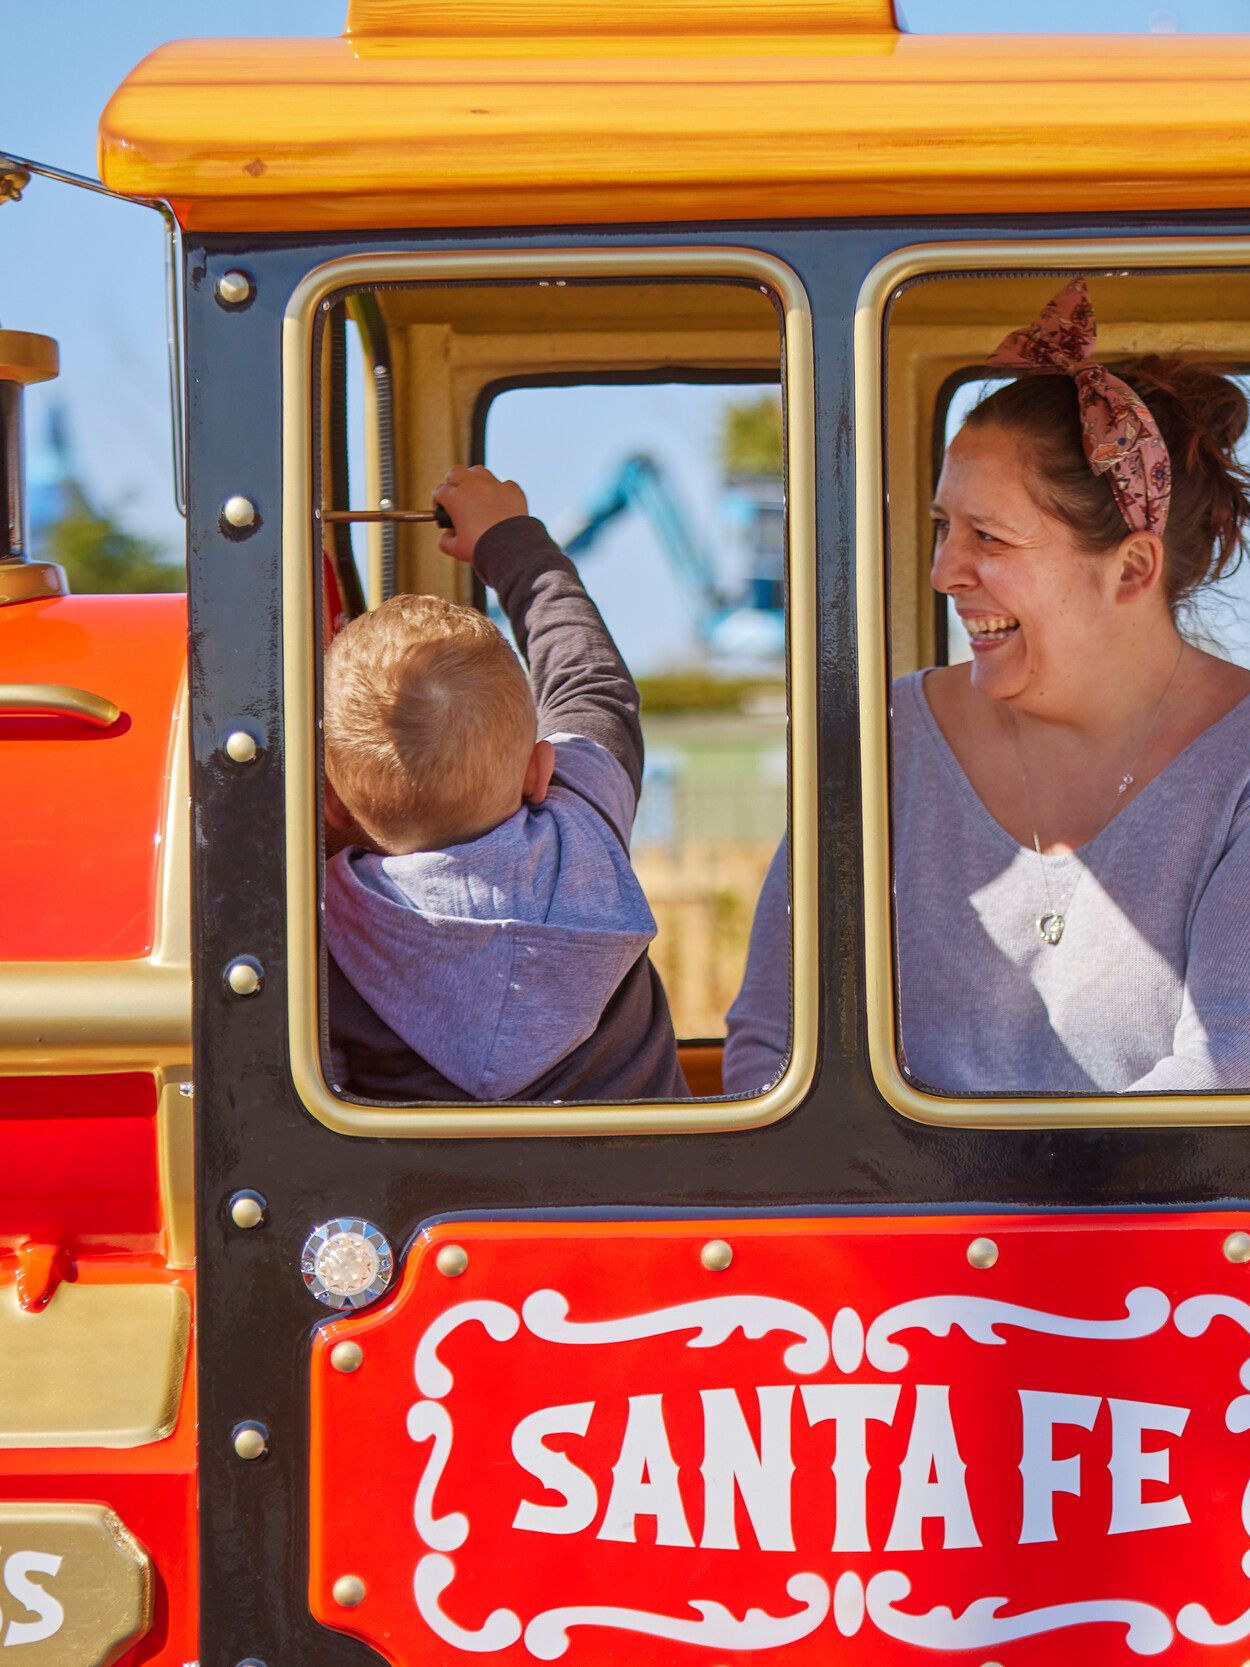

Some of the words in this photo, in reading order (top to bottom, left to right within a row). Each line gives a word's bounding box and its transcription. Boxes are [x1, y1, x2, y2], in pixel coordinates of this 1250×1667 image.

[511, 1383, 982, 1553] SANTA
[1017, 1389, 1192, 1545] FE
[0, 1546, 65, 1647] S
